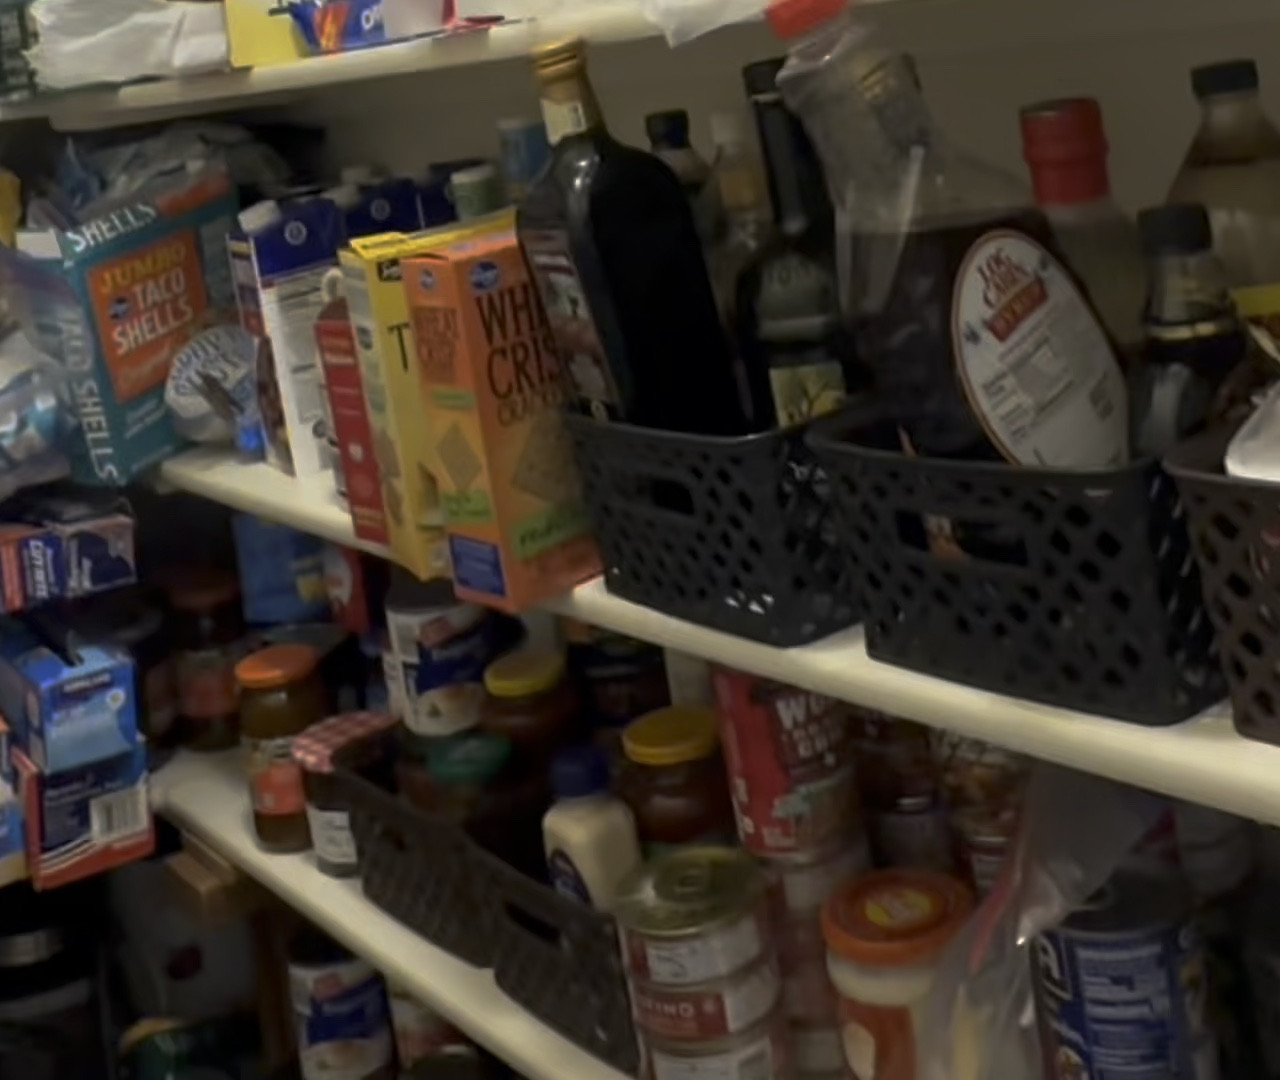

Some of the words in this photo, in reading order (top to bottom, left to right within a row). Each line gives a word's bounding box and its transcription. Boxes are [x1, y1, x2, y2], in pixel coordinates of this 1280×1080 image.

[66, 202, 158, 254] SHELLS
[99, 241, 187, 294] JUMBO
[131, 268, 186, 311] TACO
[112, 296, 193, 355] SHELLS
[75, 378, 118, 481] SHELLS
